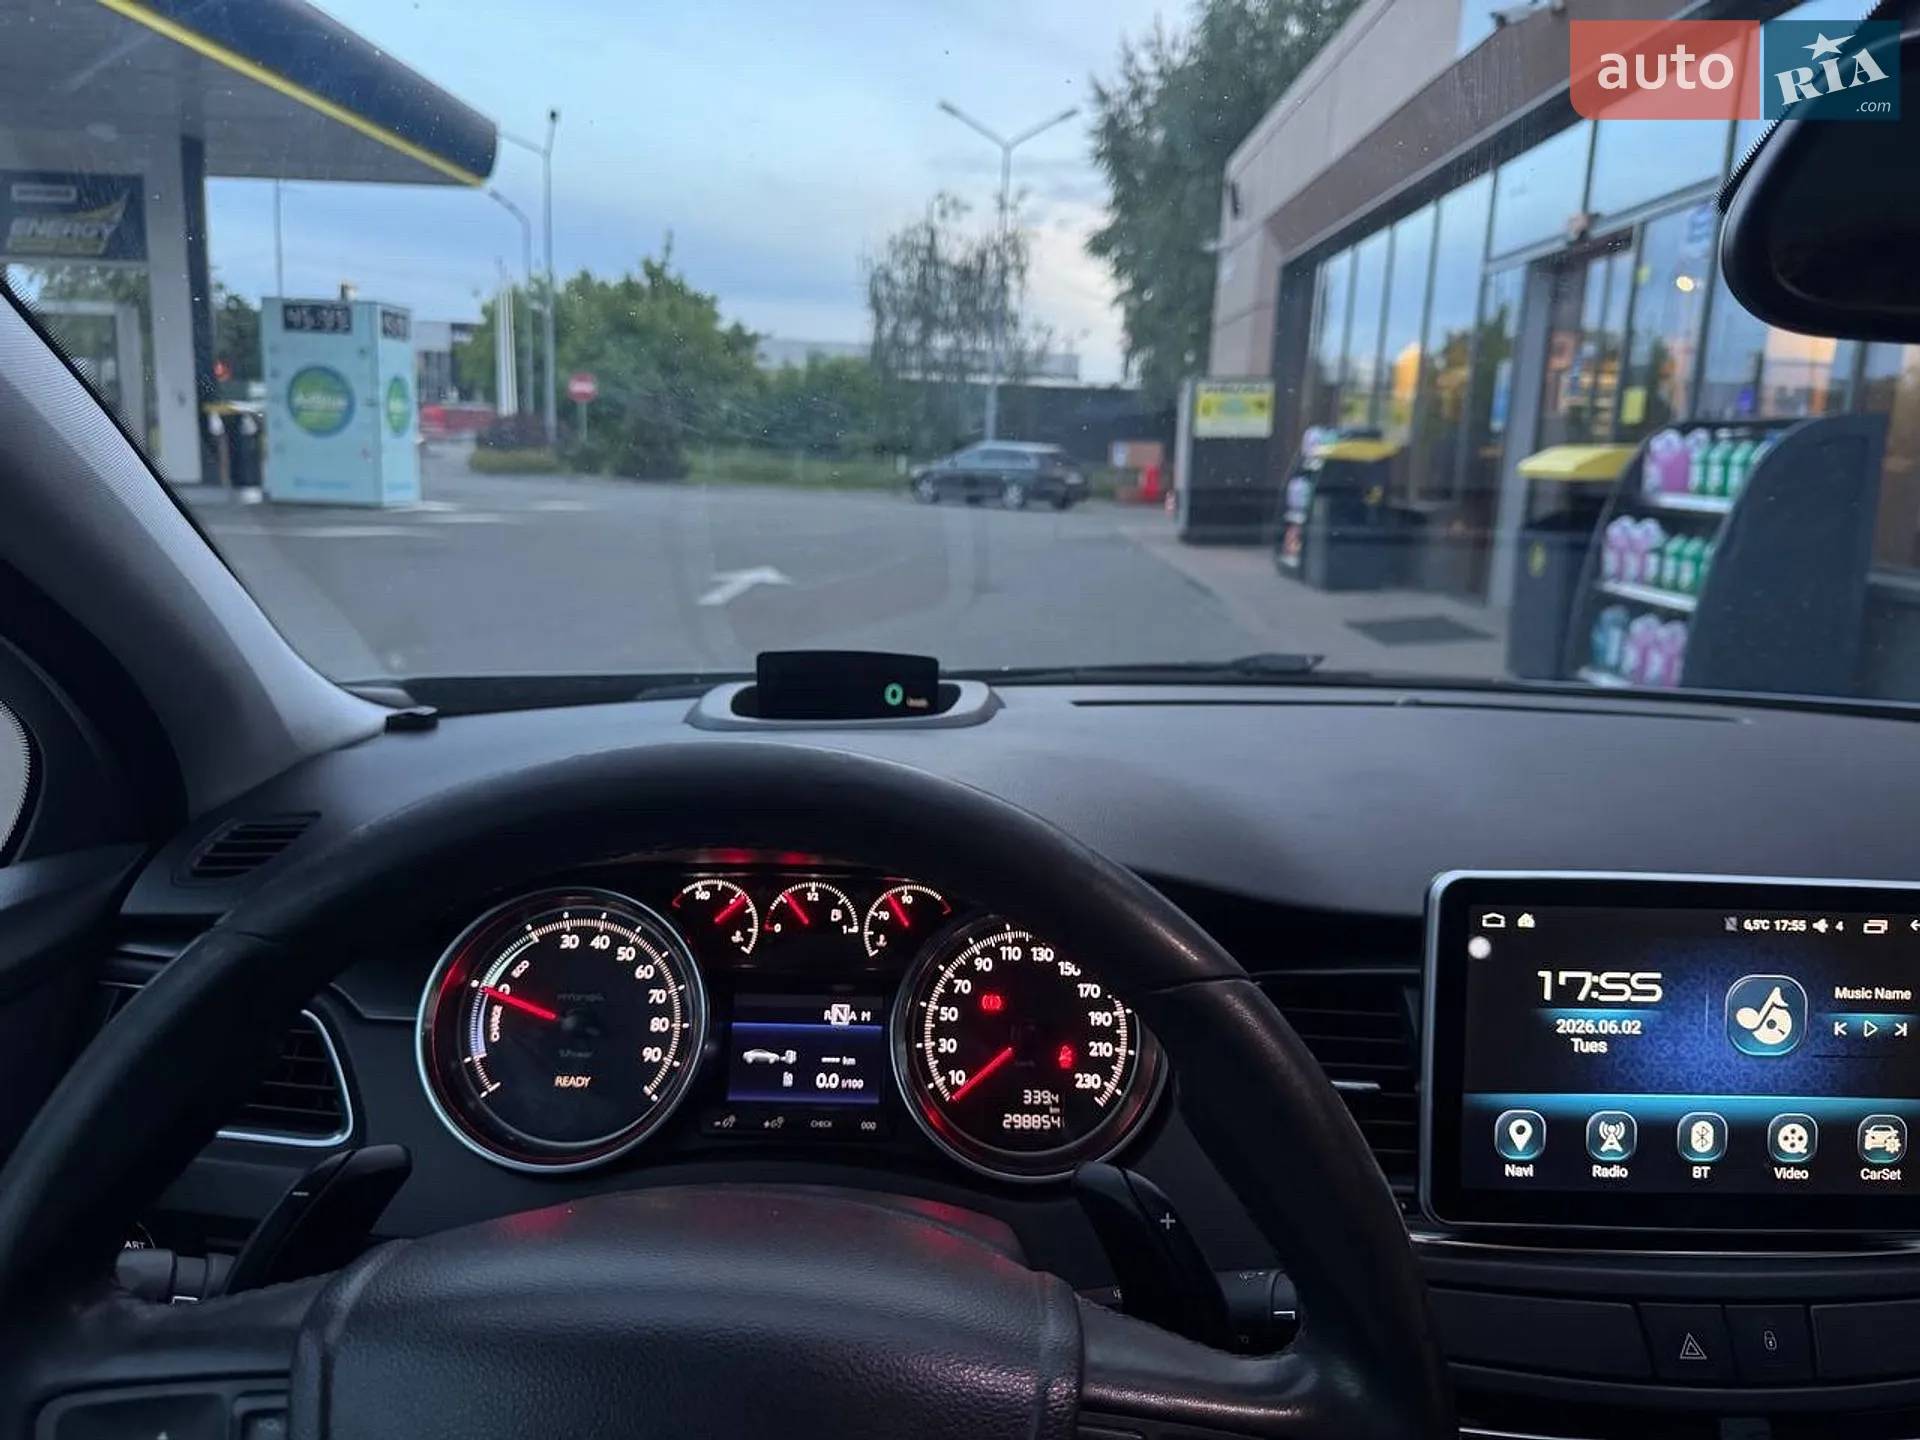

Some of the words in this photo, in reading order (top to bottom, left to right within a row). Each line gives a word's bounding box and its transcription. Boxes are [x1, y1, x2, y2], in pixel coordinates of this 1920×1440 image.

[885, 683, 903, 705] 0
[877, 911, 889, 920] 70
[774, 923, 781, 932] 0
[1774, 920, 1806, 931] 17:55
[1835, 921, 1843, 931] 4
[560, 935, 579, 949] 30
[590, 935, 610, 949] 40
[616, 947, 635, 961] 50
[1000, 946, 1022, 961] 110
[1031, 947, 1054, 962] 130
[635, 962, 656, 979] 60
[974, 957, 992, 972] 90
[954, 978, 972, 994] 70
[1077, 983, 1100, 998] 170
[1538, 970, 1663, 1003] 17:55
[1835, 987, 1872, 999] Music
[1875, 987, 1911, 1000] Name
[649, 989, 669, 1004] 70
[940, 1006, 958, 1021] 50
[1088, 1011, 1112, 1027] 190
[650, 1017, 669, 1032] 80
[1556, 1018, 1642, 1035] 2026.06.02
[938, 1038, 957, 1053] 30
[1089, 1041, 1113, 1057] 210
[1570, 1038, 1608, 1054] Tues
[643, 1047, 662, 1062] 90
[555, 1076, 591, 1087] READY
[816, 1073, 839, 1088] 0.0
[949, 1070, 966, 1085] 10
[1075, 1073, 1101, 1089] 230
[1505, 1164, 1533, 1177] Navi
[1592, 1165, 1628, 1178] Radio
[1693, 1166, 1711, 1178] BT
[1774, 1167, 1808, 1179] Video
[1861, 1168, 1901, 1180] CarSet
[125, 1240, 145, 1249] ART
